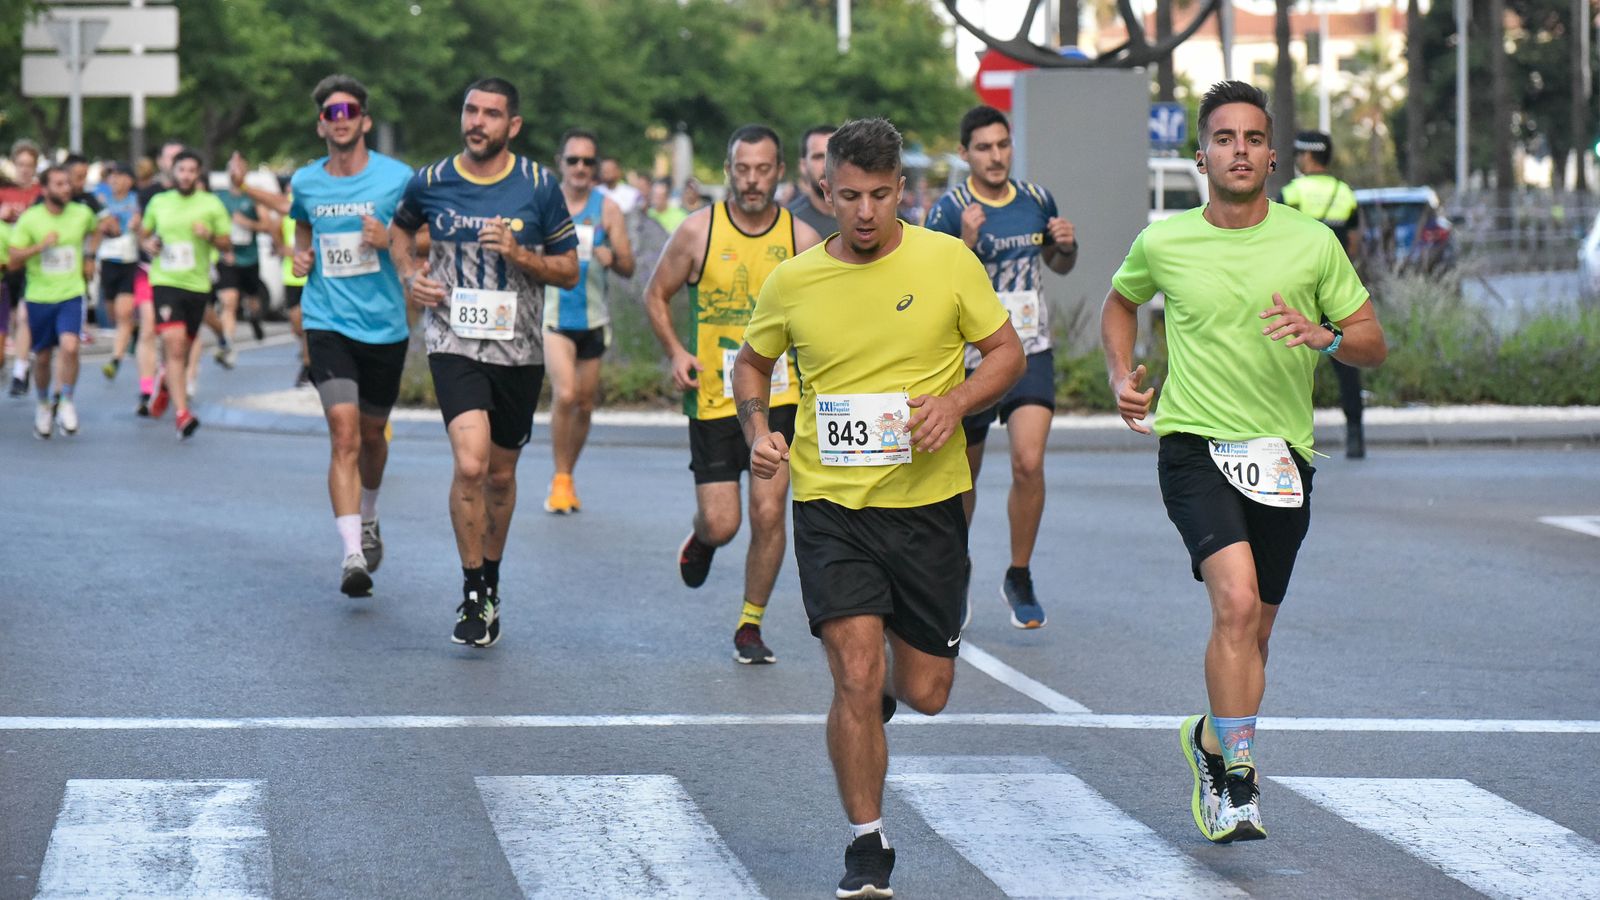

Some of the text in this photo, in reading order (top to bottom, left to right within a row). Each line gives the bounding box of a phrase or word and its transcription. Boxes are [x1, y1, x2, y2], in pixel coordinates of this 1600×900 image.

[327, 249, 352, 264] 926
[459, 306, 488, 325] 833
[819, 401, 833, 412] XXI
[827, 420, 869, 446] 843
[1222, 461, 1260, 487] 410
